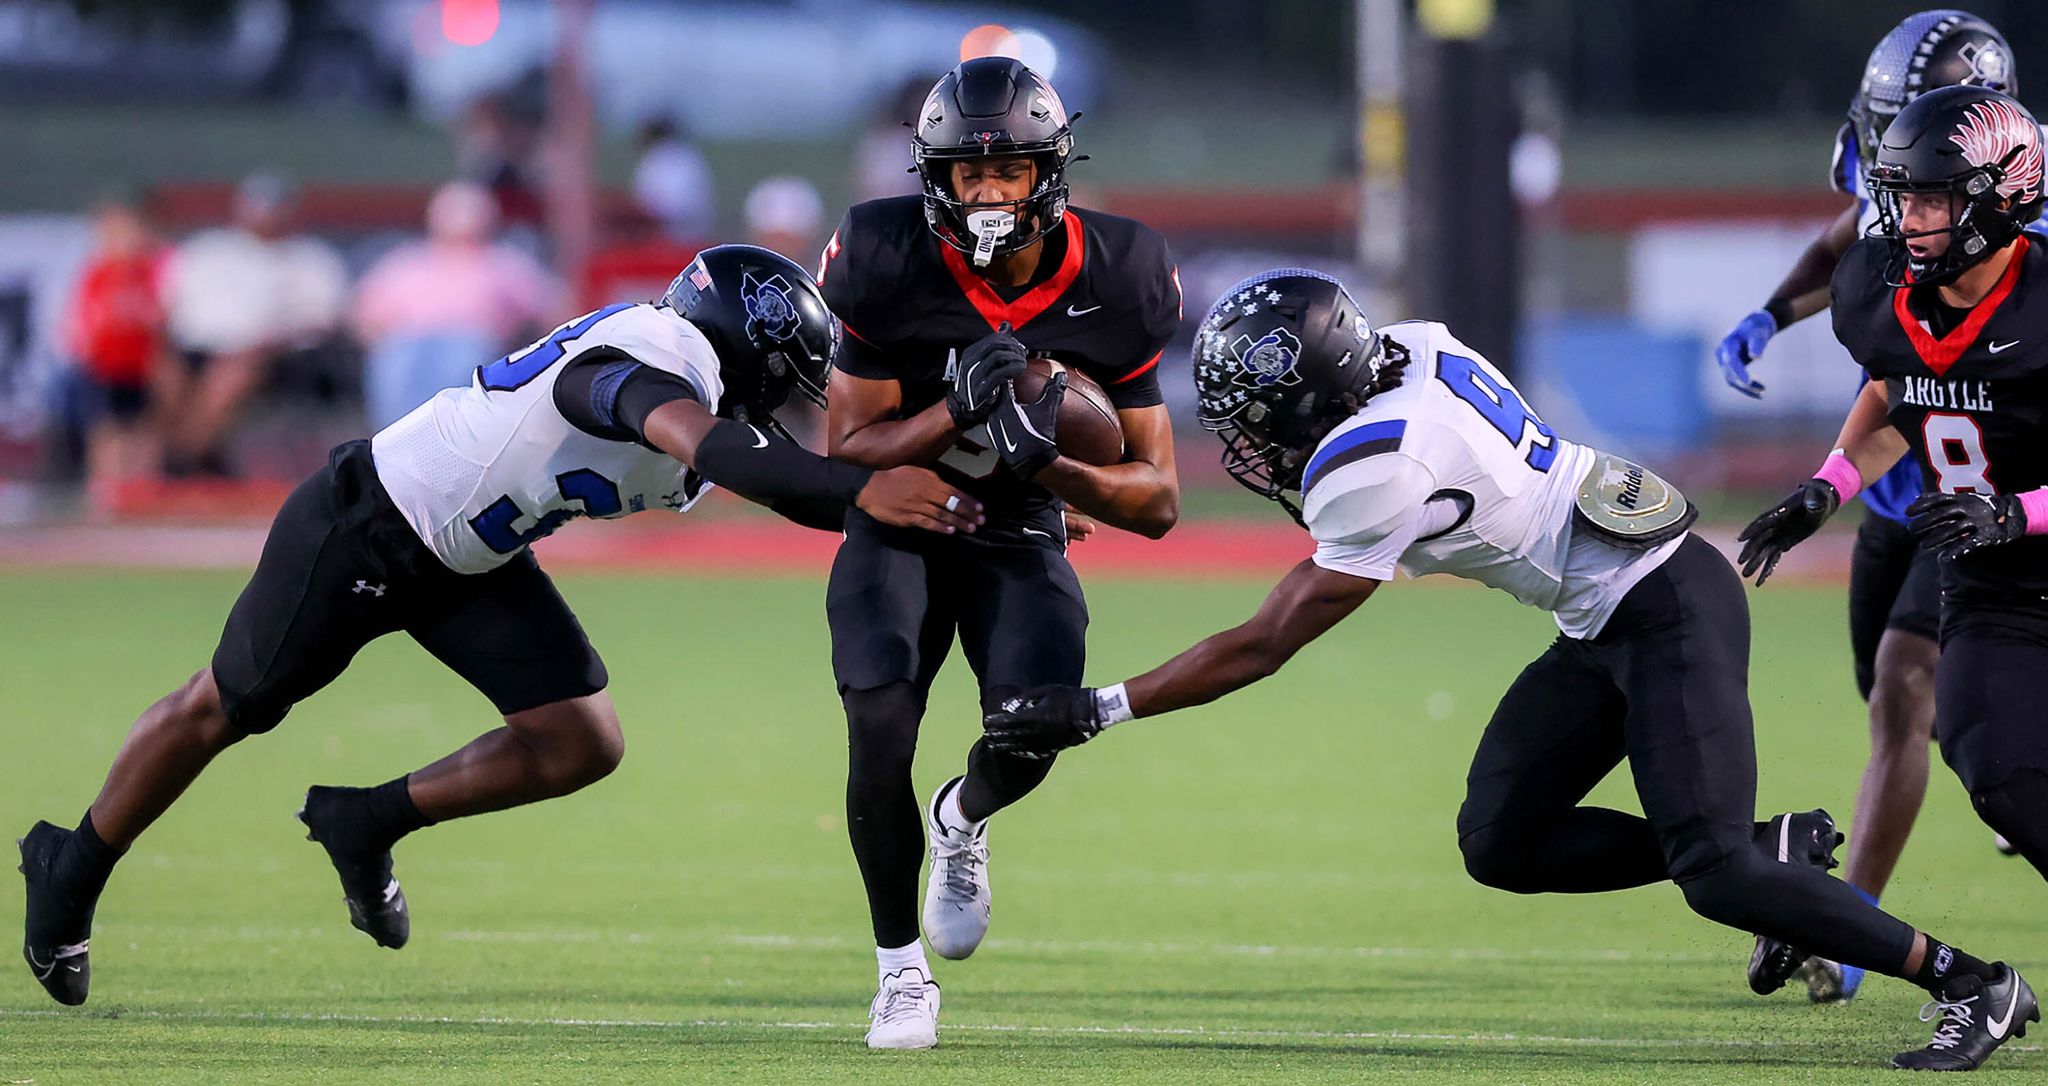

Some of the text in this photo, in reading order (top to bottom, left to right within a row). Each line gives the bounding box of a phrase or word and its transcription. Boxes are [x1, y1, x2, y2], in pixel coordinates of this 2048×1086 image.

[1435, 350, 1559, 474] 9
[1902, 375, 1994, 412] ARGYLE
[1616, 462, 1644, 510] Riddell
